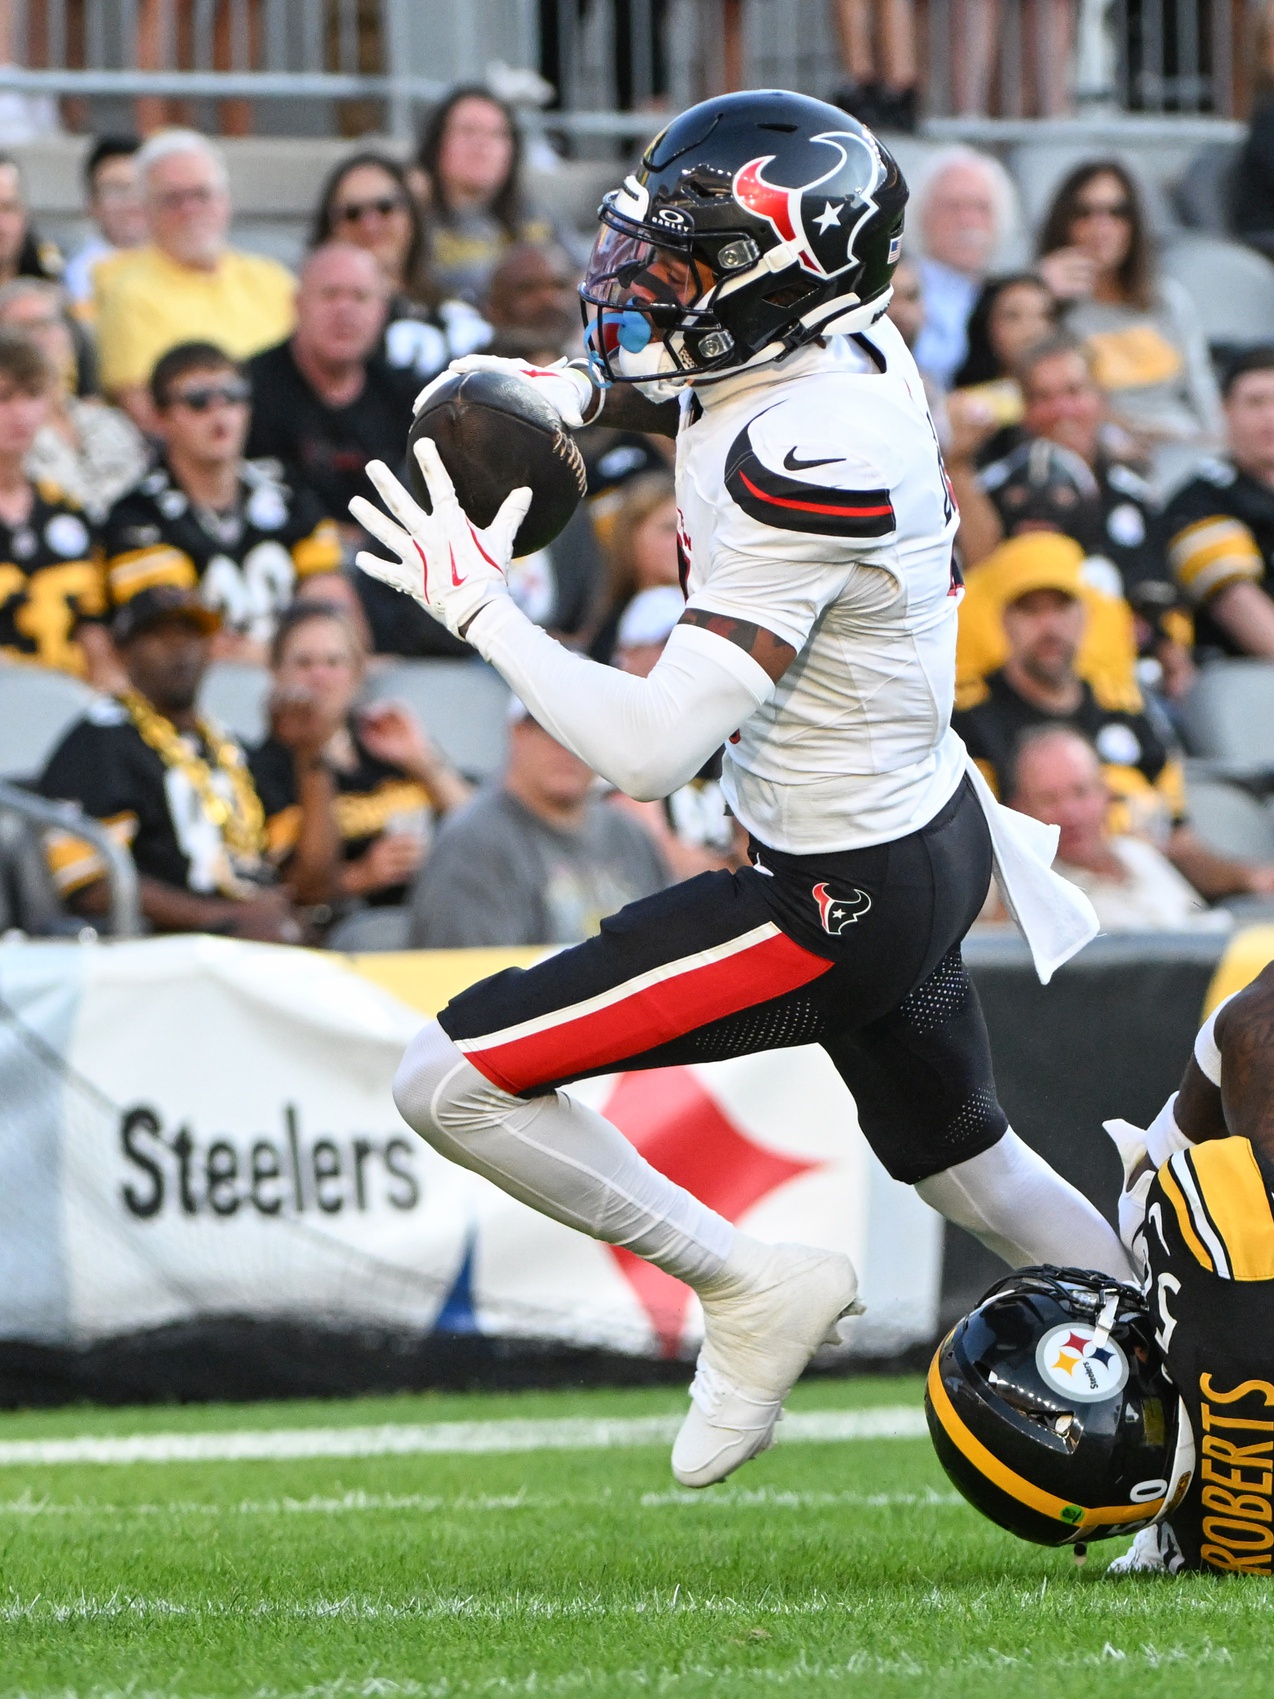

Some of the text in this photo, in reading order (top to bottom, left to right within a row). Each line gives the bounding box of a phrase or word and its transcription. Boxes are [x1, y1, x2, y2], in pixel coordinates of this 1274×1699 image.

[651, 216, 690, 232] OAKLEY
[120, 1100, 420, 1217] Steelers
[1082, 1360, 1099, 1391] Steelers
